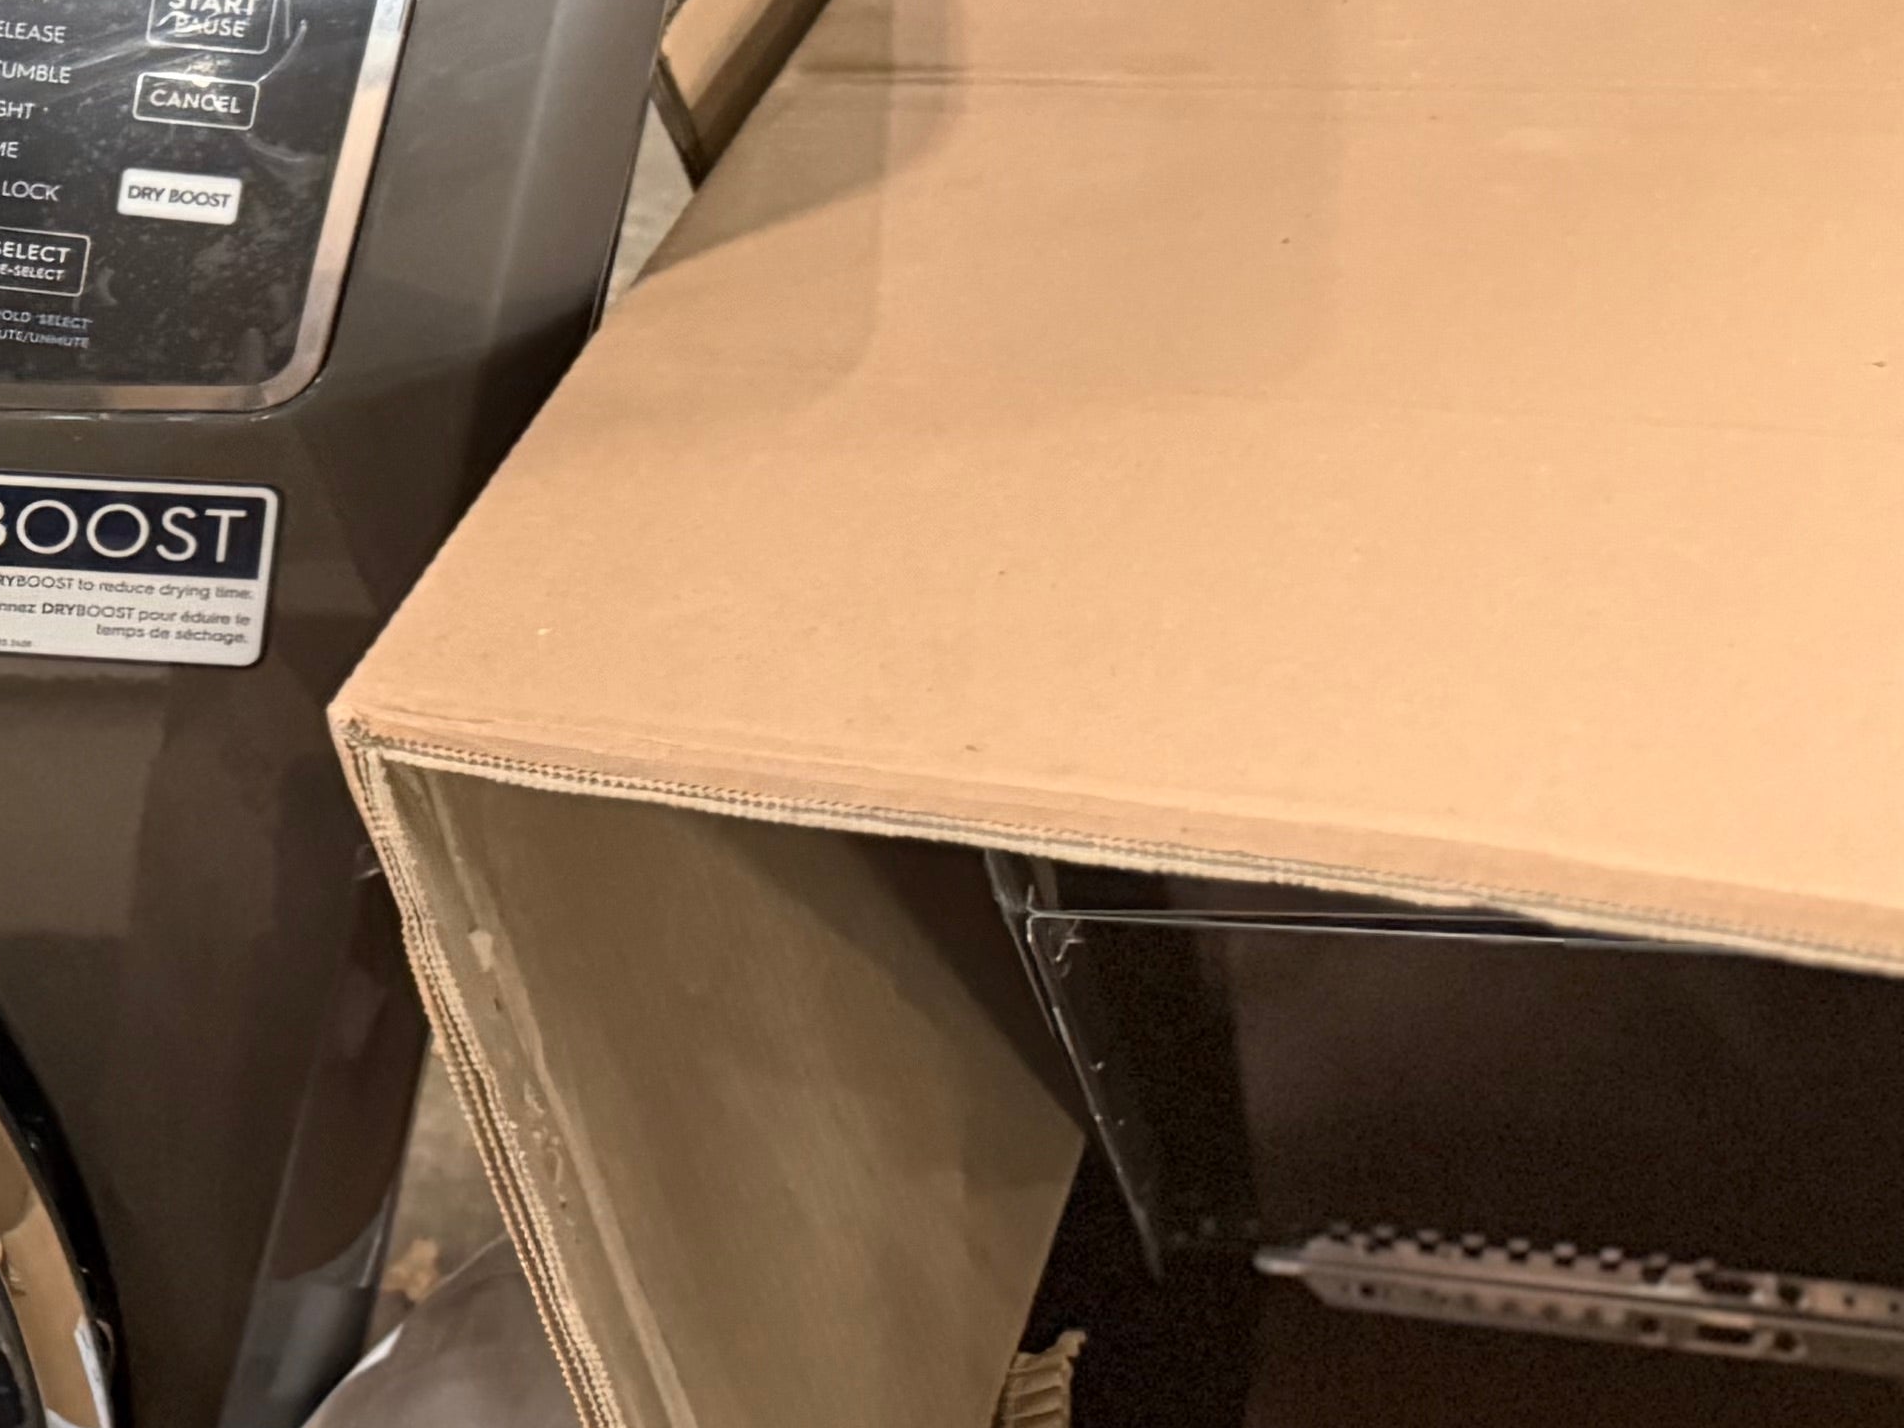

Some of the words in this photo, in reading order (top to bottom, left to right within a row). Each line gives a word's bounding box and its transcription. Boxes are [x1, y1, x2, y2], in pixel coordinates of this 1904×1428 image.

[175, 15, 250, 38] PAUSE
[150, 89, 240, 114] CANCEL
[2, 181, 62, 202] LOCK
[128, 185, 165, 203] DRY
[168, 190, 232, 208] BOOST
[77, 577, 95, 591] to
[99, 579, 154, 595] reduce
[159, 583, 210, 600] drying
[42, 602, 135, 620] DRYBOOST
[138, 609, 178, 623] pour
[96, 623, 146, 640] temps
[149, 626, 170, 640] de
